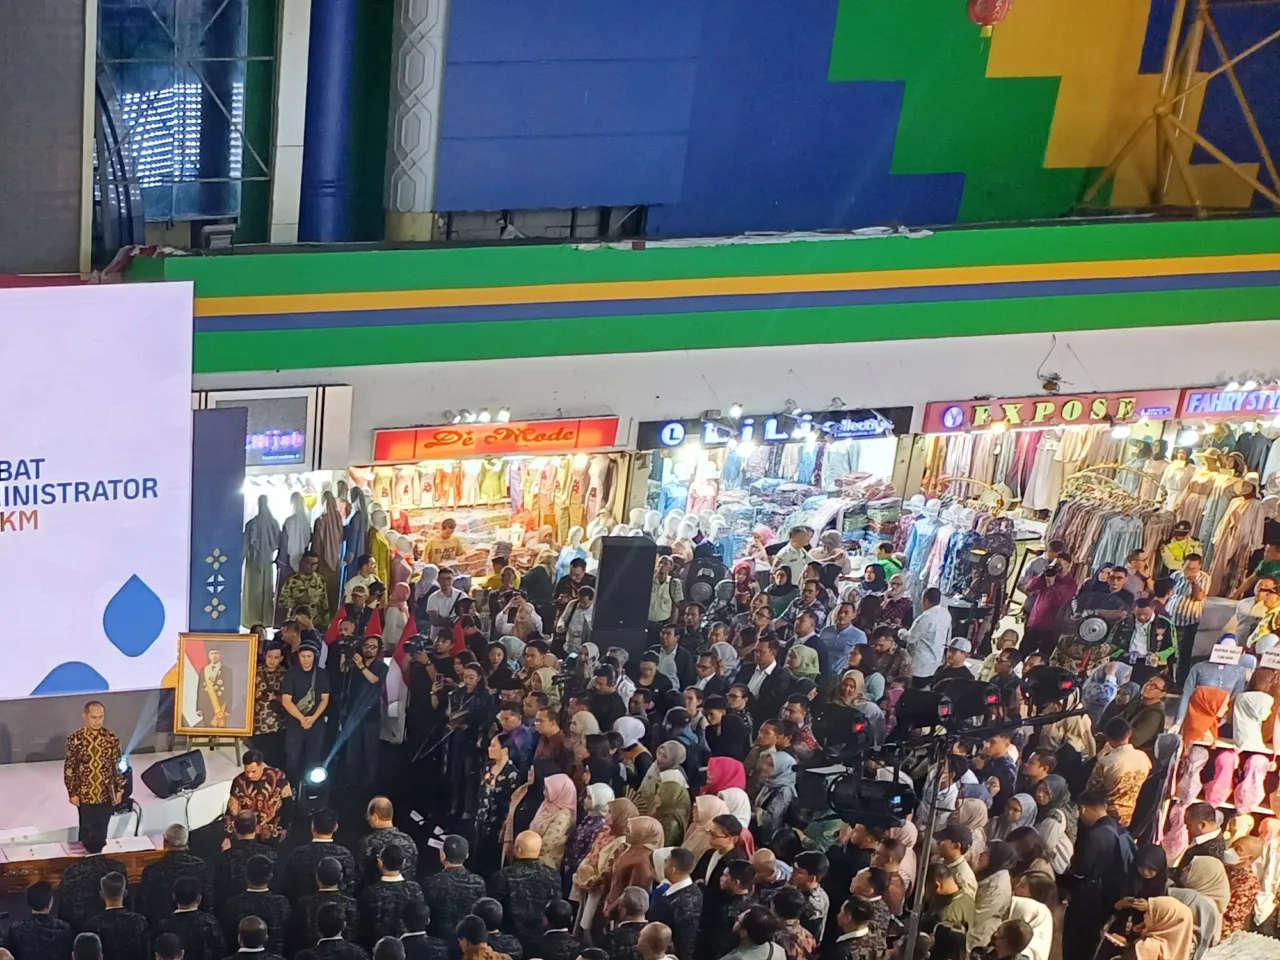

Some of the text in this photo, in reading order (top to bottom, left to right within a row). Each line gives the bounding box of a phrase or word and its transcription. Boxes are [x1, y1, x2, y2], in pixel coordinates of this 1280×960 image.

[972, 397, 1137, 427] EXPOSE
[1186, 391, 1247, 413] FAHRY
[484, 427, 575, 445] Mode
